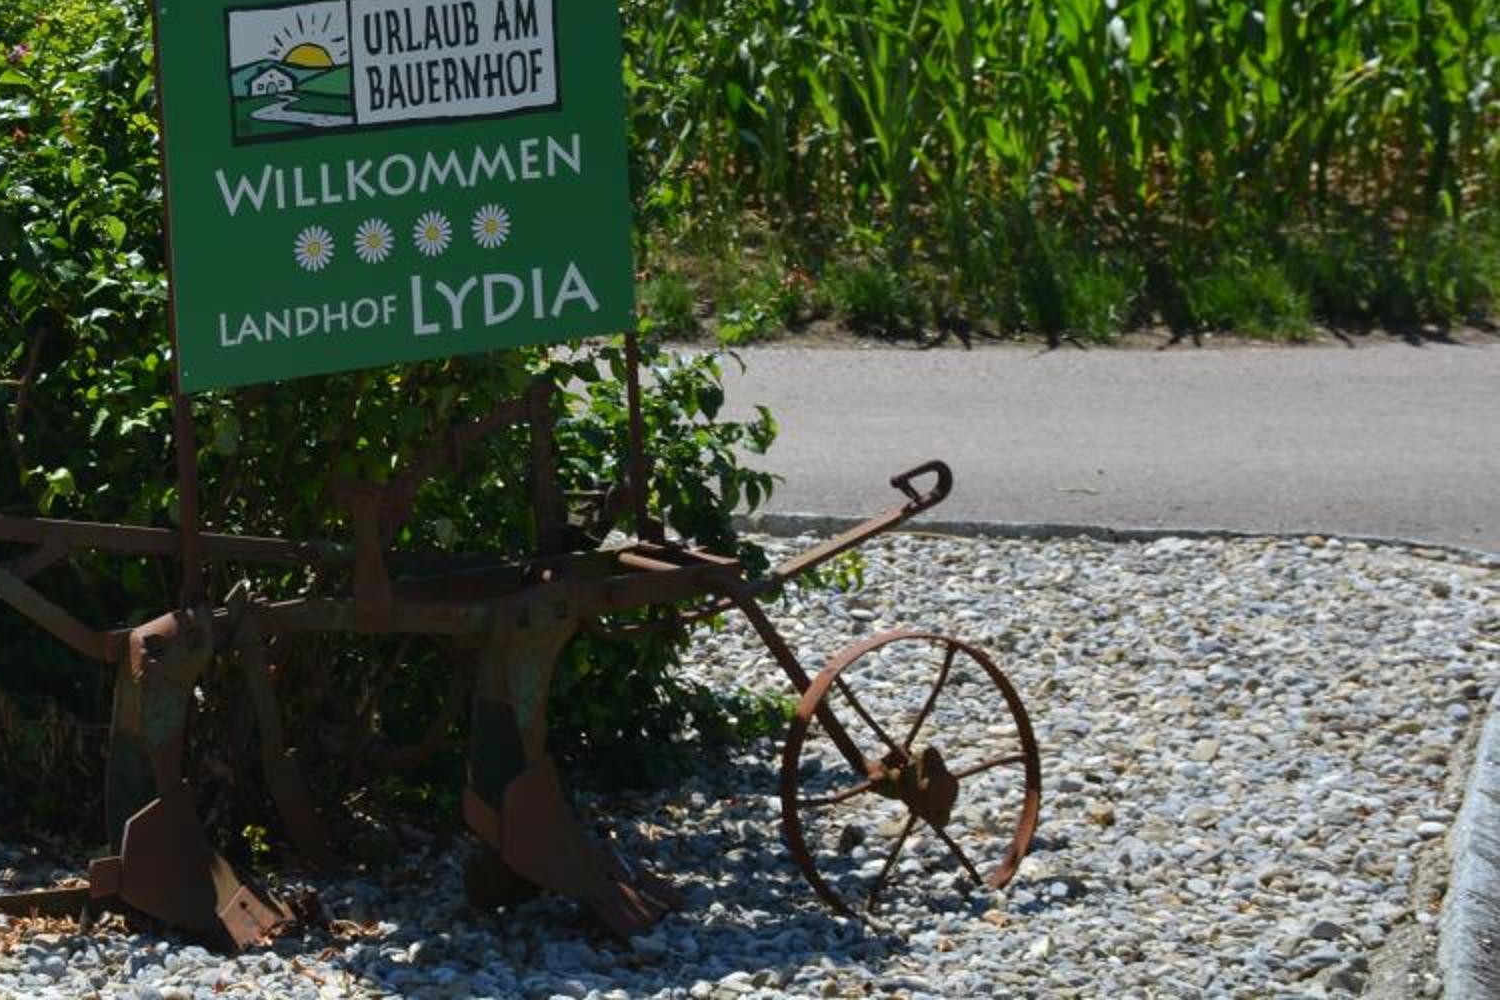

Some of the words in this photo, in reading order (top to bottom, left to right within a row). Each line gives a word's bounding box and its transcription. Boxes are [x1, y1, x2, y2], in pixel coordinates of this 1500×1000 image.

[363, 0, 479, 55] URLAUB
[366, 48, 543, 111] BAUERNHOF
[215, 133, 581, 217] WILLKOMMEN
[219, 295, 397, 347] LANDHOF
[411, 261, 599, 336] LYDIA
